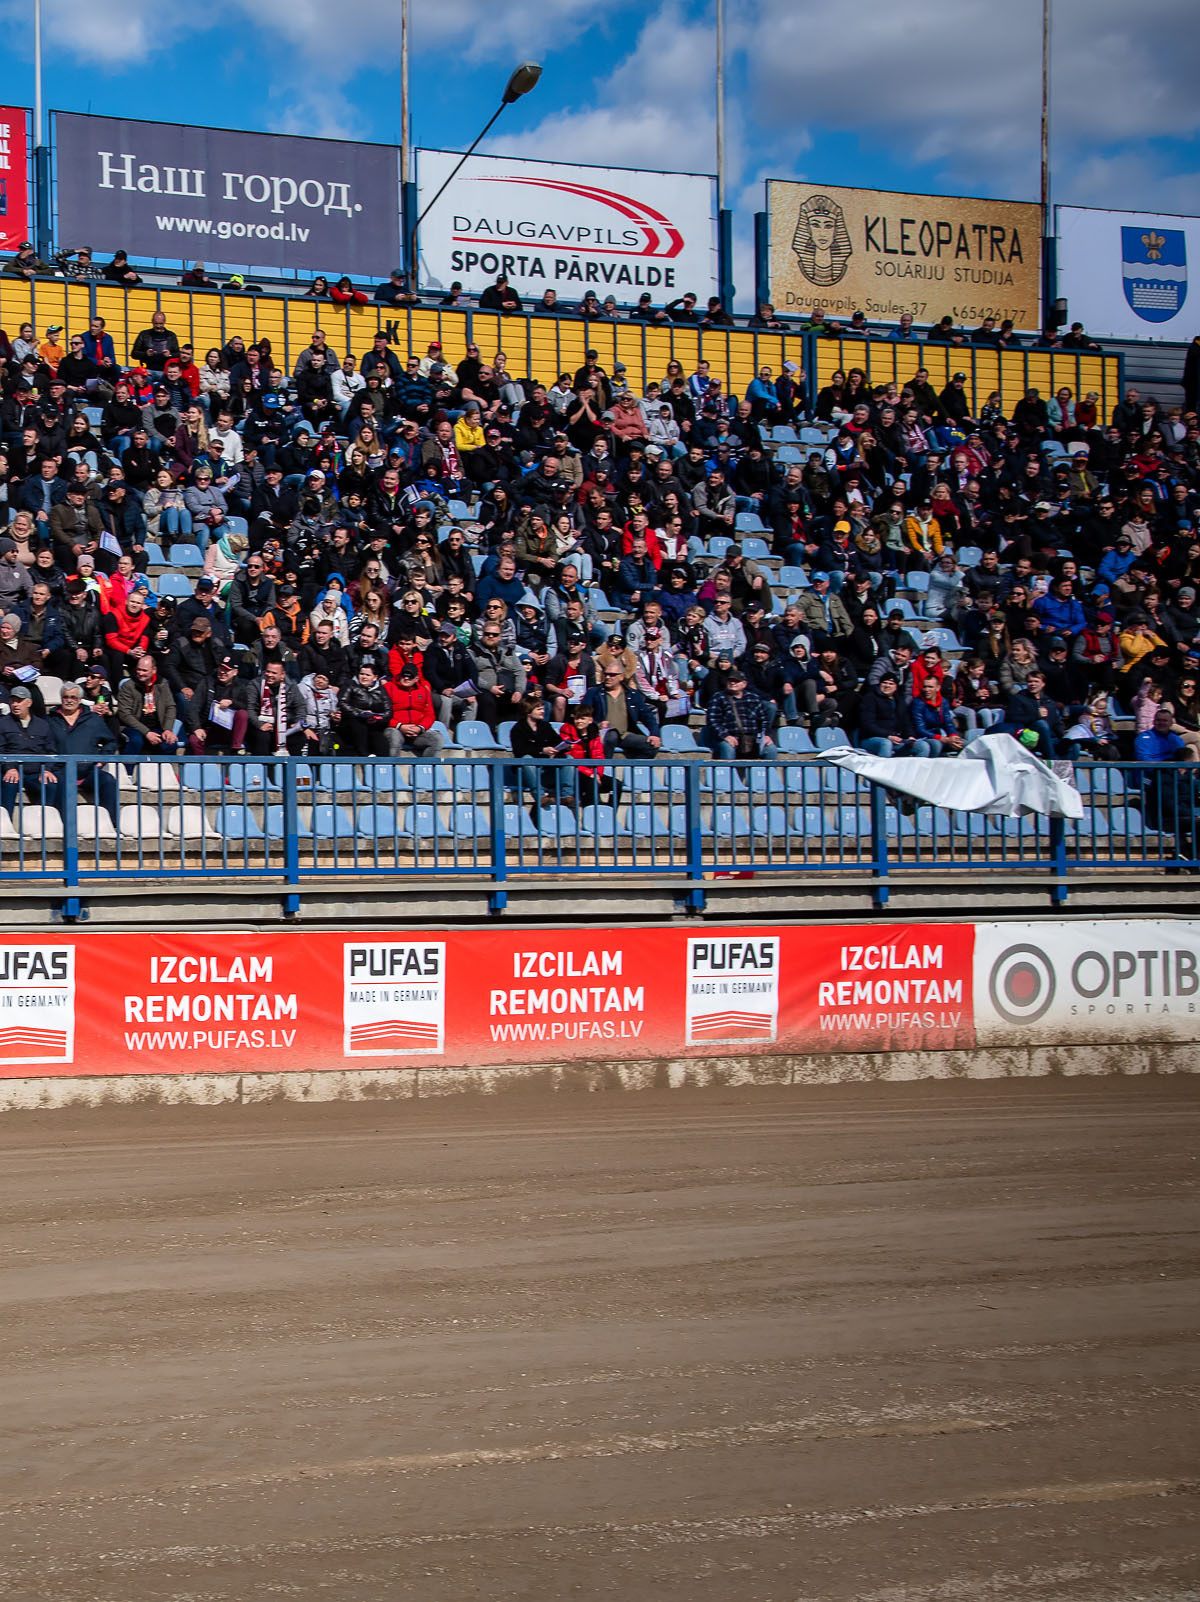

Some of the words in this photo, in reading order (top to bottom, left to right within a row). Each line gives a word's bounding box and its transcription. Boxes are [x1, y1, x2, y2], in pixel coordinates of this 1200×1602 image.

[97, 151, 206, 198] Наш
[222, 170, 363, 218] город.
[155, 214, 310, 243] www.gorod.lv
[453, 215, 639, 246] DAUGAVPILS
[865, 214, 1023, 264] KLEOPATRA
[451, 250, 546, 278] SPORTA
[555, 255, 676, 287] PĀRVALDE
[875, 260, 945, 281] SOLĀRIJU
[954, 267, 1014, 286] STUDIJA
[386, 320, 400, 345] K
[350, 948, 439, 976] PUFAS
[513, 950, 622, 978] IZCILAM
[693, 942, 774, 969] PUFAS
[841, 945, 944, 970] IZCILAM
[150, 956, 272, 983] IZCILAM
[2, 996, 14, 1007] IN
[18, 995, 67, 1008] GERMANY
[350, 990, 377, 1003] MADE
[380, 990, 389, 1002] IN
[393, 989, 438, 1001] GERMANY
[489, 986, 645, 1015] REMONTAM
[692, 983, 716, 995] MADE
[720, 983, 728, 993] IN
[731, 982, 773, 994] GERMANY
[818, 979, 962, 1006] REMONTAM
[124, 994, 298, 1023] REMONTAM
[819, 1011, 961, 1030] WWW.PUFAS.LV
[1071, 1003, 1169, 1015] SPORTA
[124, 1029, 296, 1051] WWW.PUFAS.LV
[490, 1020, 643, 1042] WWW.PUFAS.LV
